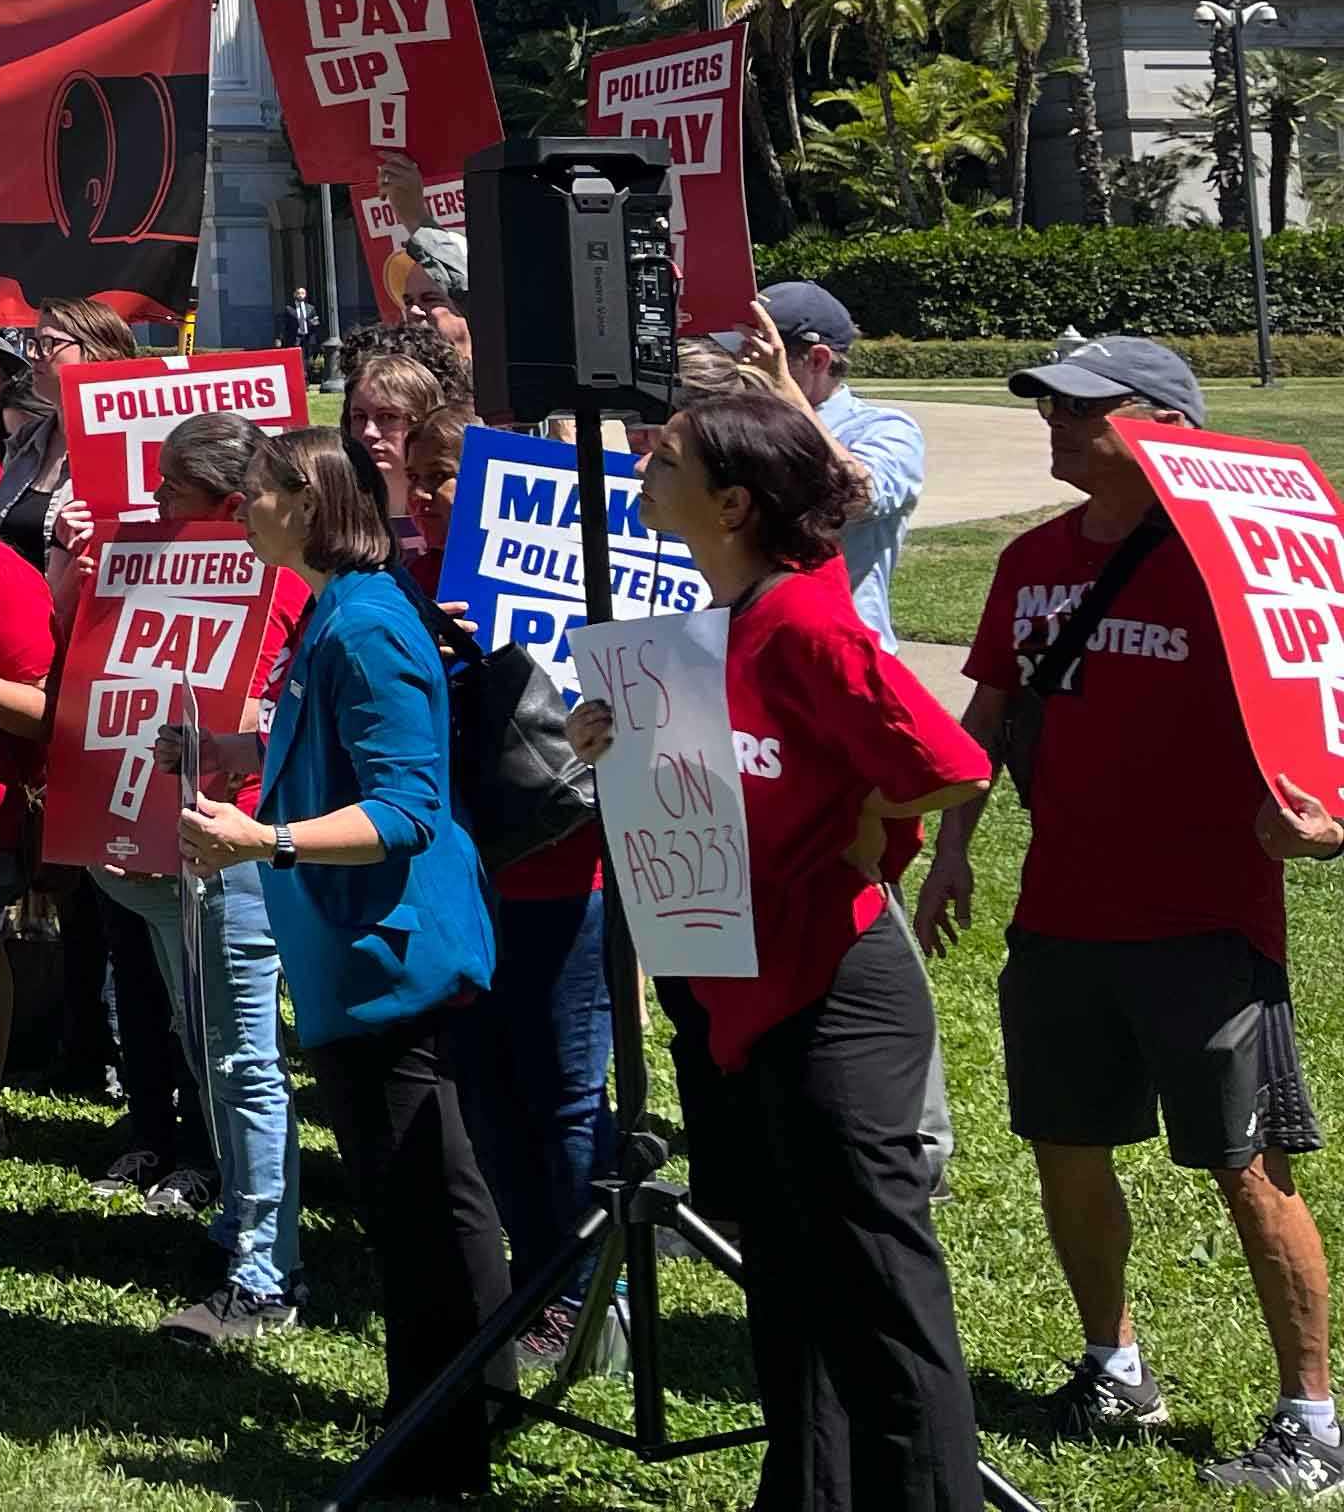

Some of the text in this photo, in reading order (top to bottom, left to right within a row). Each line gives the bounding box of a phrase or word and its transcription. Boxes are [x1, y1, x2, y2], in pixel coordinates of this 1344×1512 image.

[320, 52, 388, 94] UP
[606, 53, 723, 106] POLLUTERS
[381, 102, 396, 139] !
[371, 189, 466, 229] POTERS
[94, 378, 277, 423] POLLUTERS
[1160, 453, 1317, 502] POLLUTERS
[499, 473, 650, 540] MAK
[107, 551, 257, 585] POLLUTERS
[496, 537, 700, 613] POLLTERS
[1015, 581, 1097, 618] MAK
[119, 609, 233, 674] PAY
[511, 607, 588, 663] PA
[1013, 616, 1190, 662] PLUTERS
[1262, 607, 1330, 664] UP
[590, 639, 670, 733] YES
[97, 689, 159, 738] UP
[121, 757, 148, 807] !
[654, 750, 714, 819] ON
